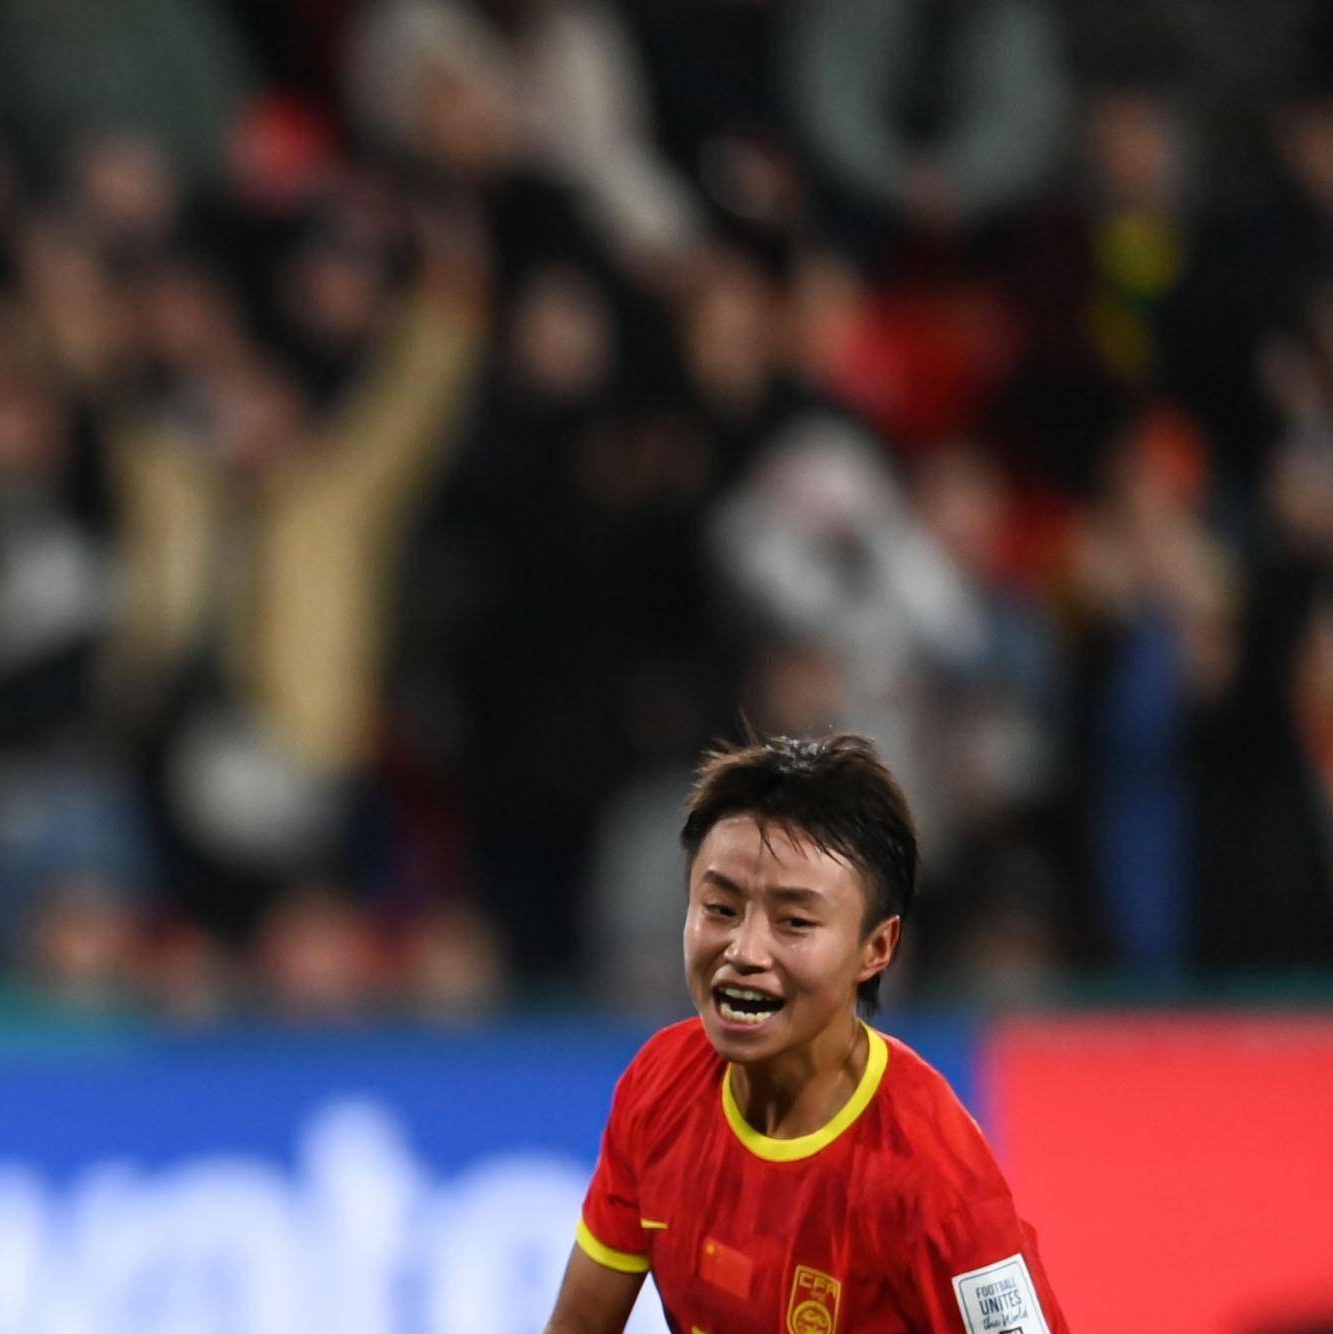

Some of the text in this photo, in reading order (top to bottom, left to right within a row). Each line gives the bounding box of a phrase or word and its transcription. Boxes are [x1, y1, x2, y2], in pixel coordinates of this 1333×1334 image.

[799, 1273, 839, 1299] CFA
[976, 1278, 1017, 1298] FOOTBALL
[979, 1289, 1021, 1315] UNITES
